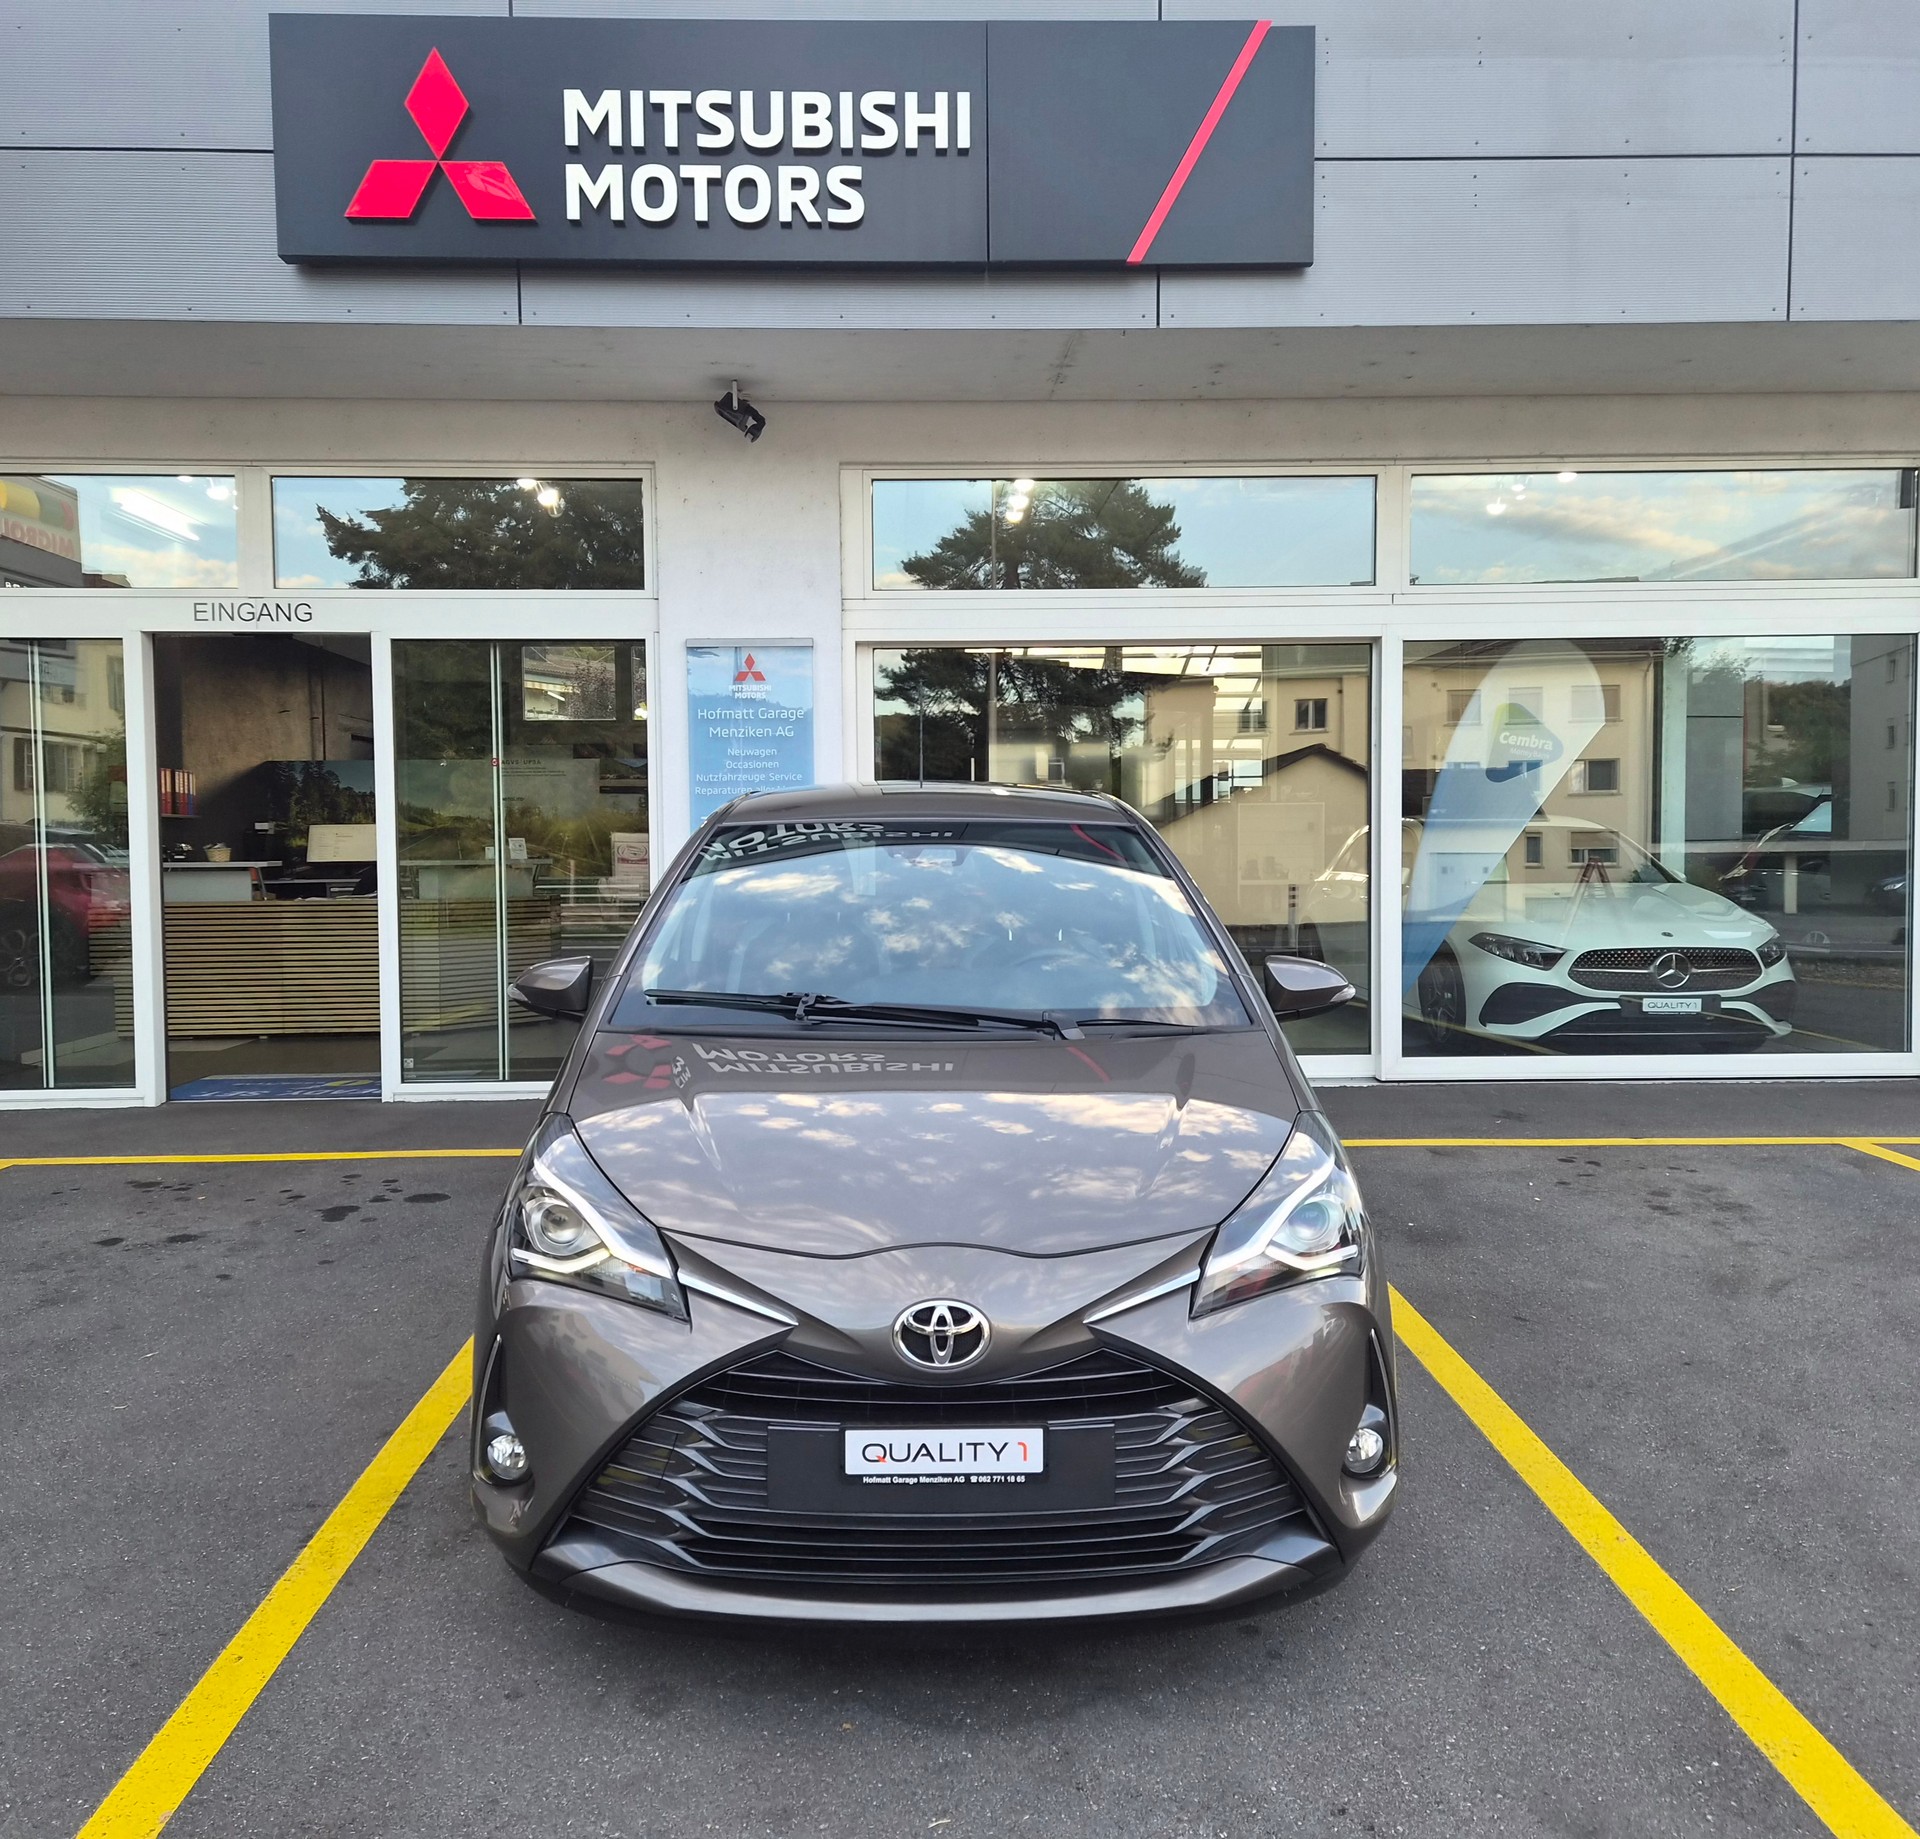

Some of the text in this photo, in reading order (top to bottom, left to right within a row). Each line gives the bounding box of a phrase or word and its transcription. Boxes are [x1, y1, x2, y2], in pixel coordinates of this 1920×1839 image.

[563, 89, 971, 149] MITSUBISHI
[565, 163, 866, 223] MOTORS
[193, 602, 313, 623] EINGANG
[728, 684, 772, 692] MITSUBISHI
[734, 691, 766, 699] MOTORS
[697, 707, 805, 722] Hofmatt Garage
[708, 725, 795, 738] Menziken AG
[1499, 731, 1553, 750] Cembra
[727, 747, 778, 757] Neuwagen
[725, 760, 780, 769] Occasionen
[696, 772, 803, 783] Nutzfahrzeuge Service
[695, 786, 753, 796] Reparaturen
[862, 1441, 1028, 1463] QUALITY 1
[863, 1476, 892, 1484] Hofmatt
[892, 1476, 918, 1485] Garage
[919, 1475, 953, 1484] Menziken
[953, 1475, 966, 1483] AG
[978, 1475, 991, 1483] 062
[992, 1475, 1005, 1483] 771
